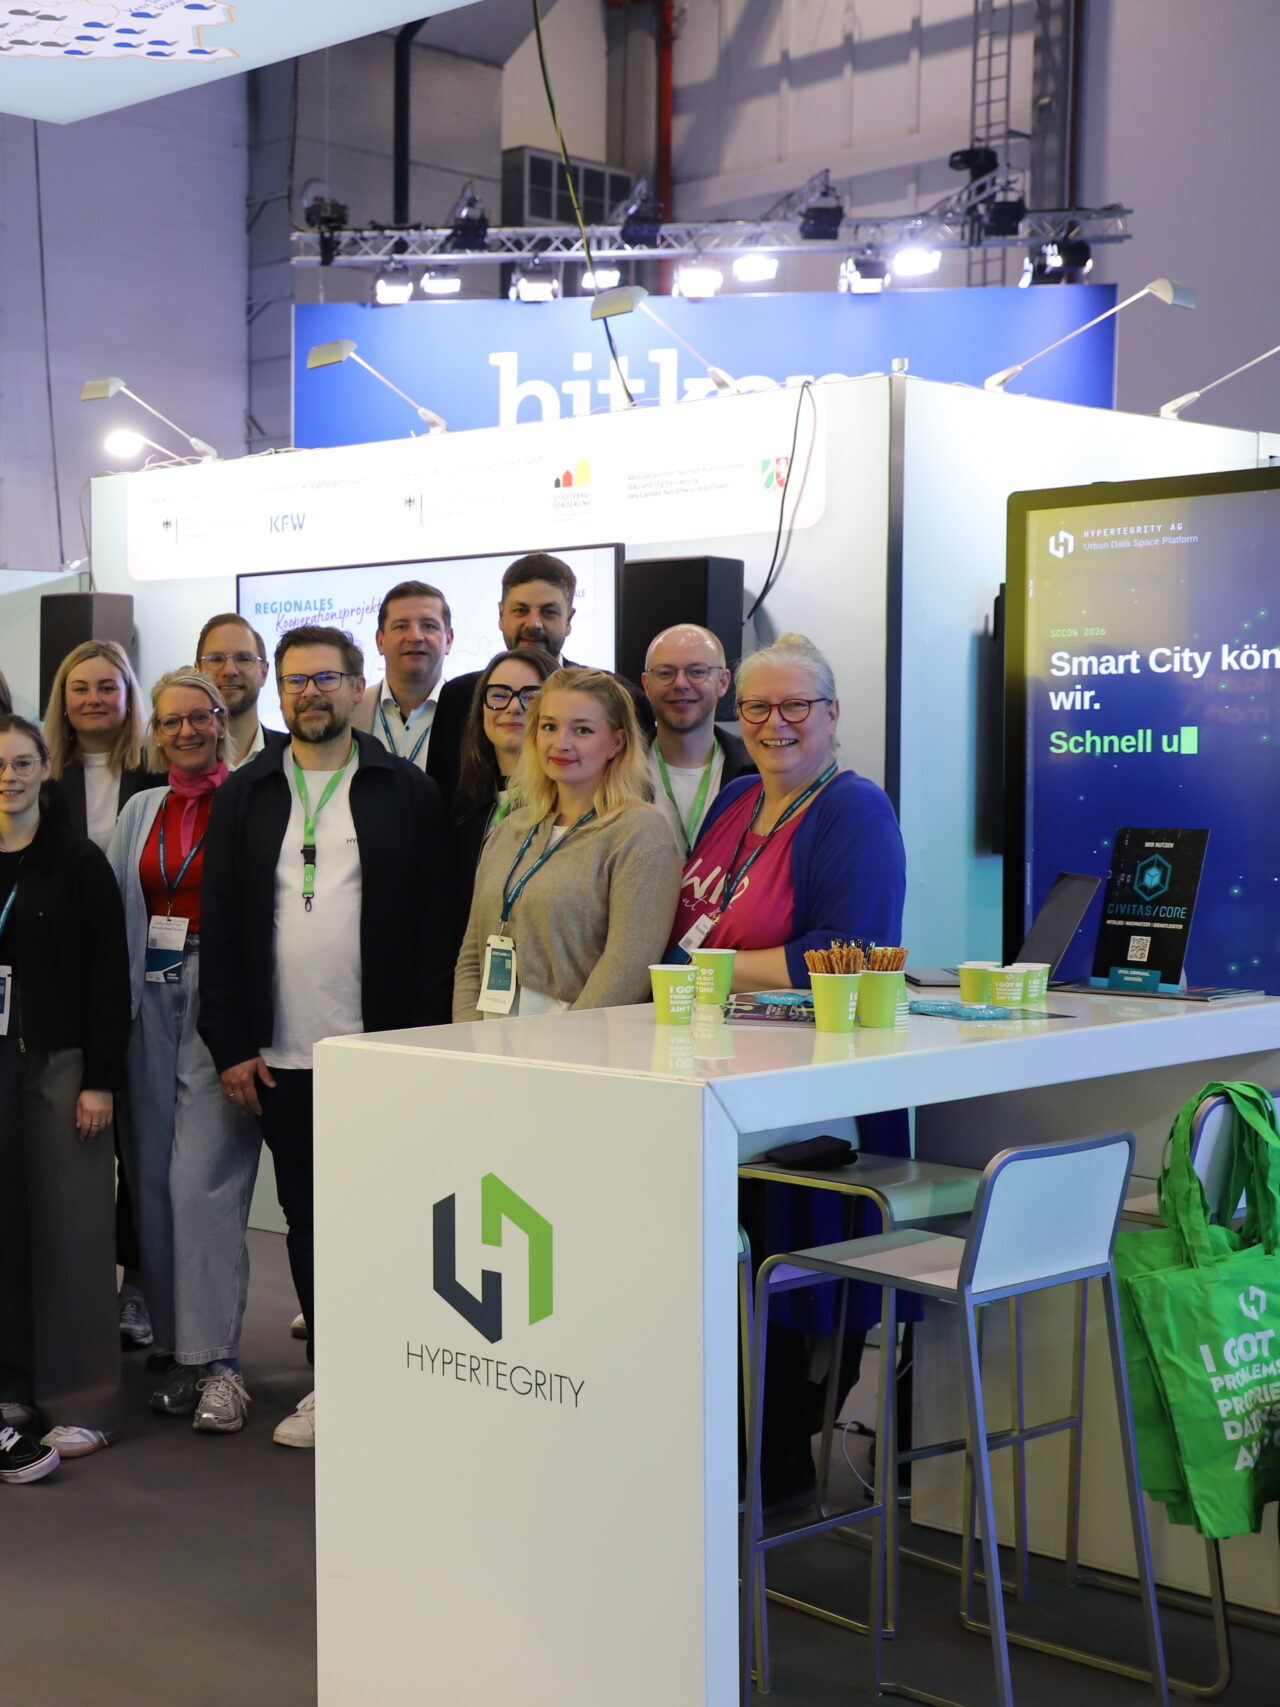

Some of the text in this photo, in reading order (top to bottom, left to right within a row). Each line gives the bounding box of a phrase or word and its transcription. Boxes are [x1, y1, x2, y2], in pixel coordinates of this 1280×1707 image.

[1083, 523, 1184, 538] HYPERTEGRITY AG
[1083, 534, 1199, 551] Urban Data Space Platform
[255, 598, 333, 615] REGIONALES
[1050, 627, 1106, 638] SCCON 2026
[1049, 649, 1141, 677] Smart
[1148, 645, 1212, 679] City
[1049, 684, 1101, 711] wir.
[1049, 728, 1153, 754] Schnell
[1199, 1328, 1275, 1373] I GOT
[406, 1340, 585, 1408] HYPERTEGRITY
